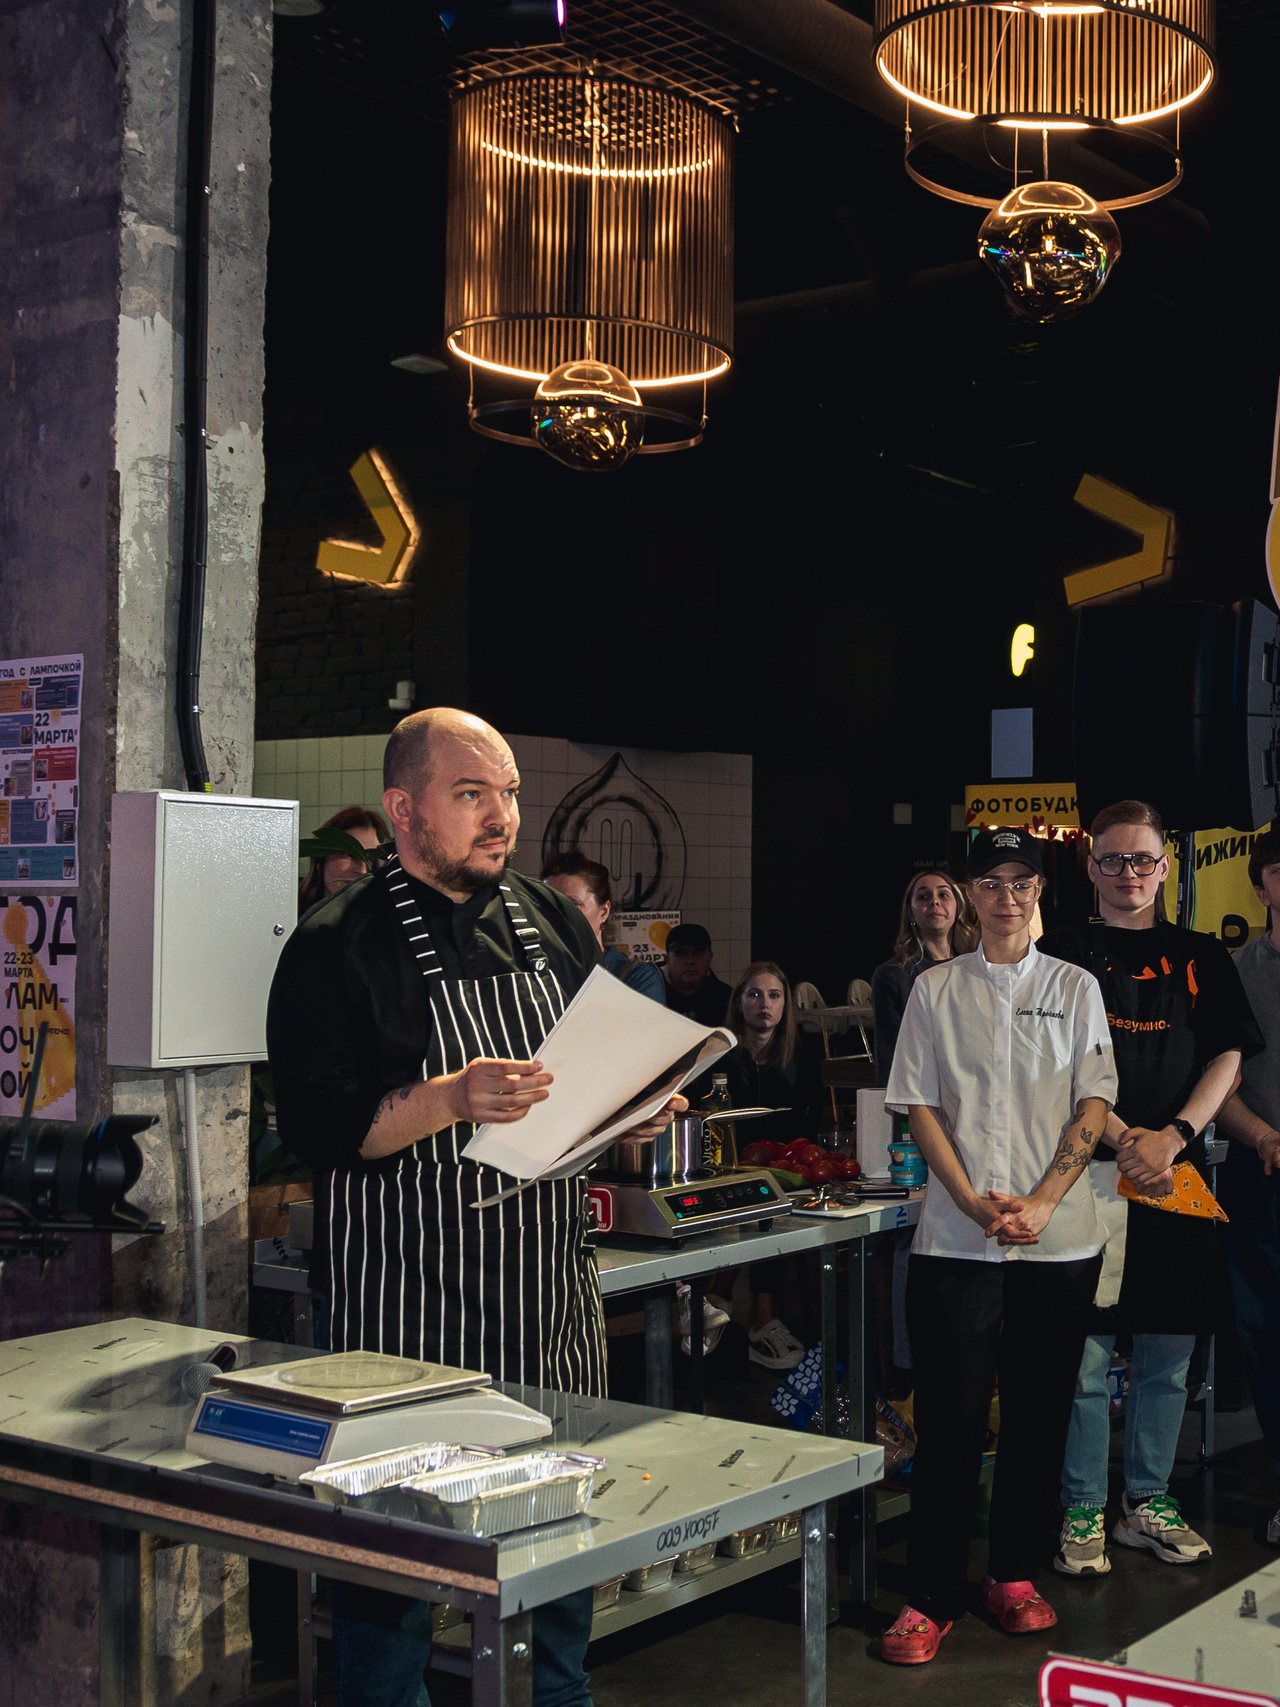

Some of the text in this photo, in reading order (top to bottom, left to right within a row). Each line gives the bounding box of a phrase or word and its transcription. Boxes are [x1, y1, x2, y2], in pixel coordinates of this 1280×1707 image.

[30, 660, 82, 676] ЛАМПОЧКОЙ
[35, 713, 50, 728] 22
[34, 729, 74, 745] МАРТА
[4, 952, 33, 964] 22-23
[4, 966, 34, 978] МАРТА
